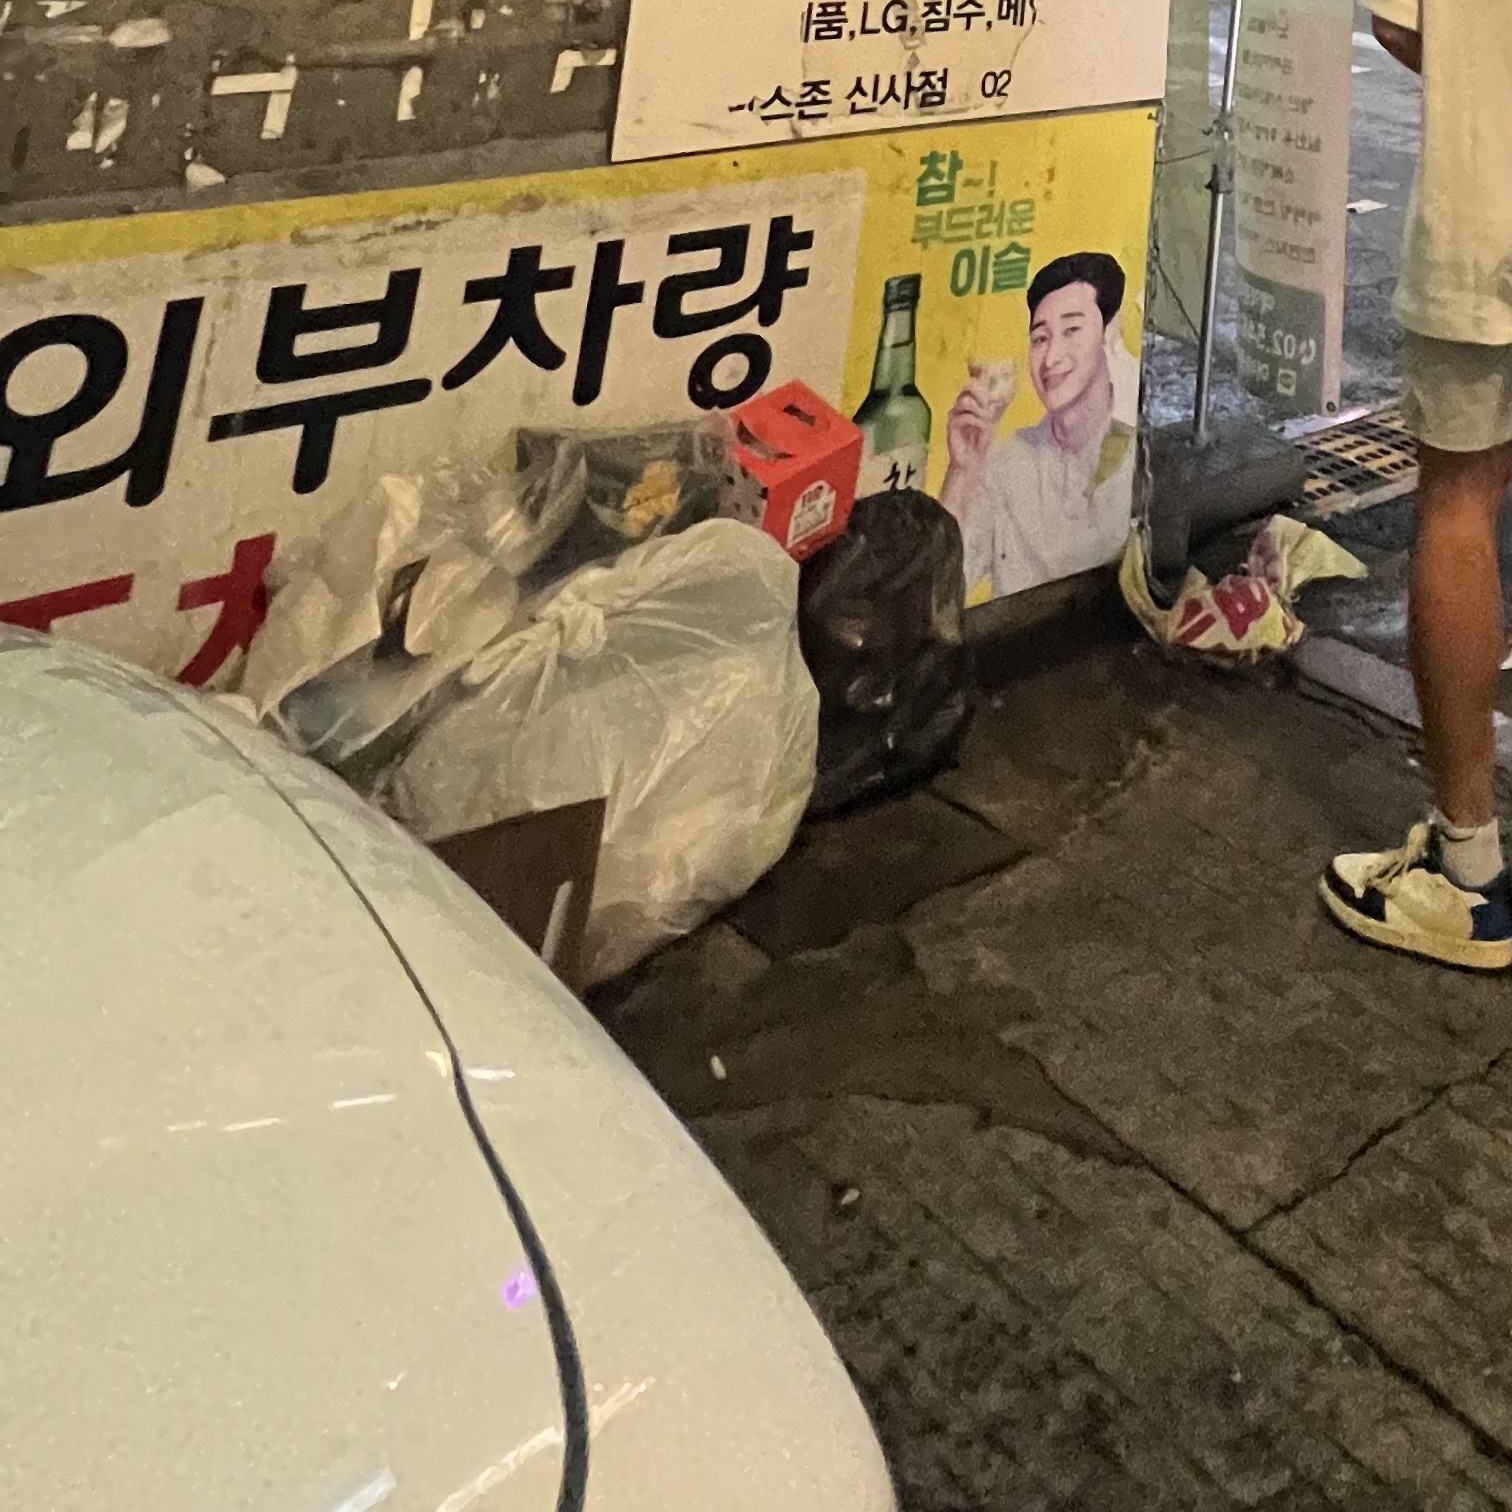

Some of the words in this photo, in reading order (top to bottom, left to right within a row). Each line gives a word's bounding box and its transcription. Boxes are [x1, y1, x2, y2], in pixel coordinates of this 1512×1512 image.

[845, 66, 949, 116] 신사점
[981, 69, 1012, 99] 02
[911, 197, 1035, 250] 부드러운
[949, 241, 1031, 298] 이슬
[0, 215, 814, 512] 외부차량
